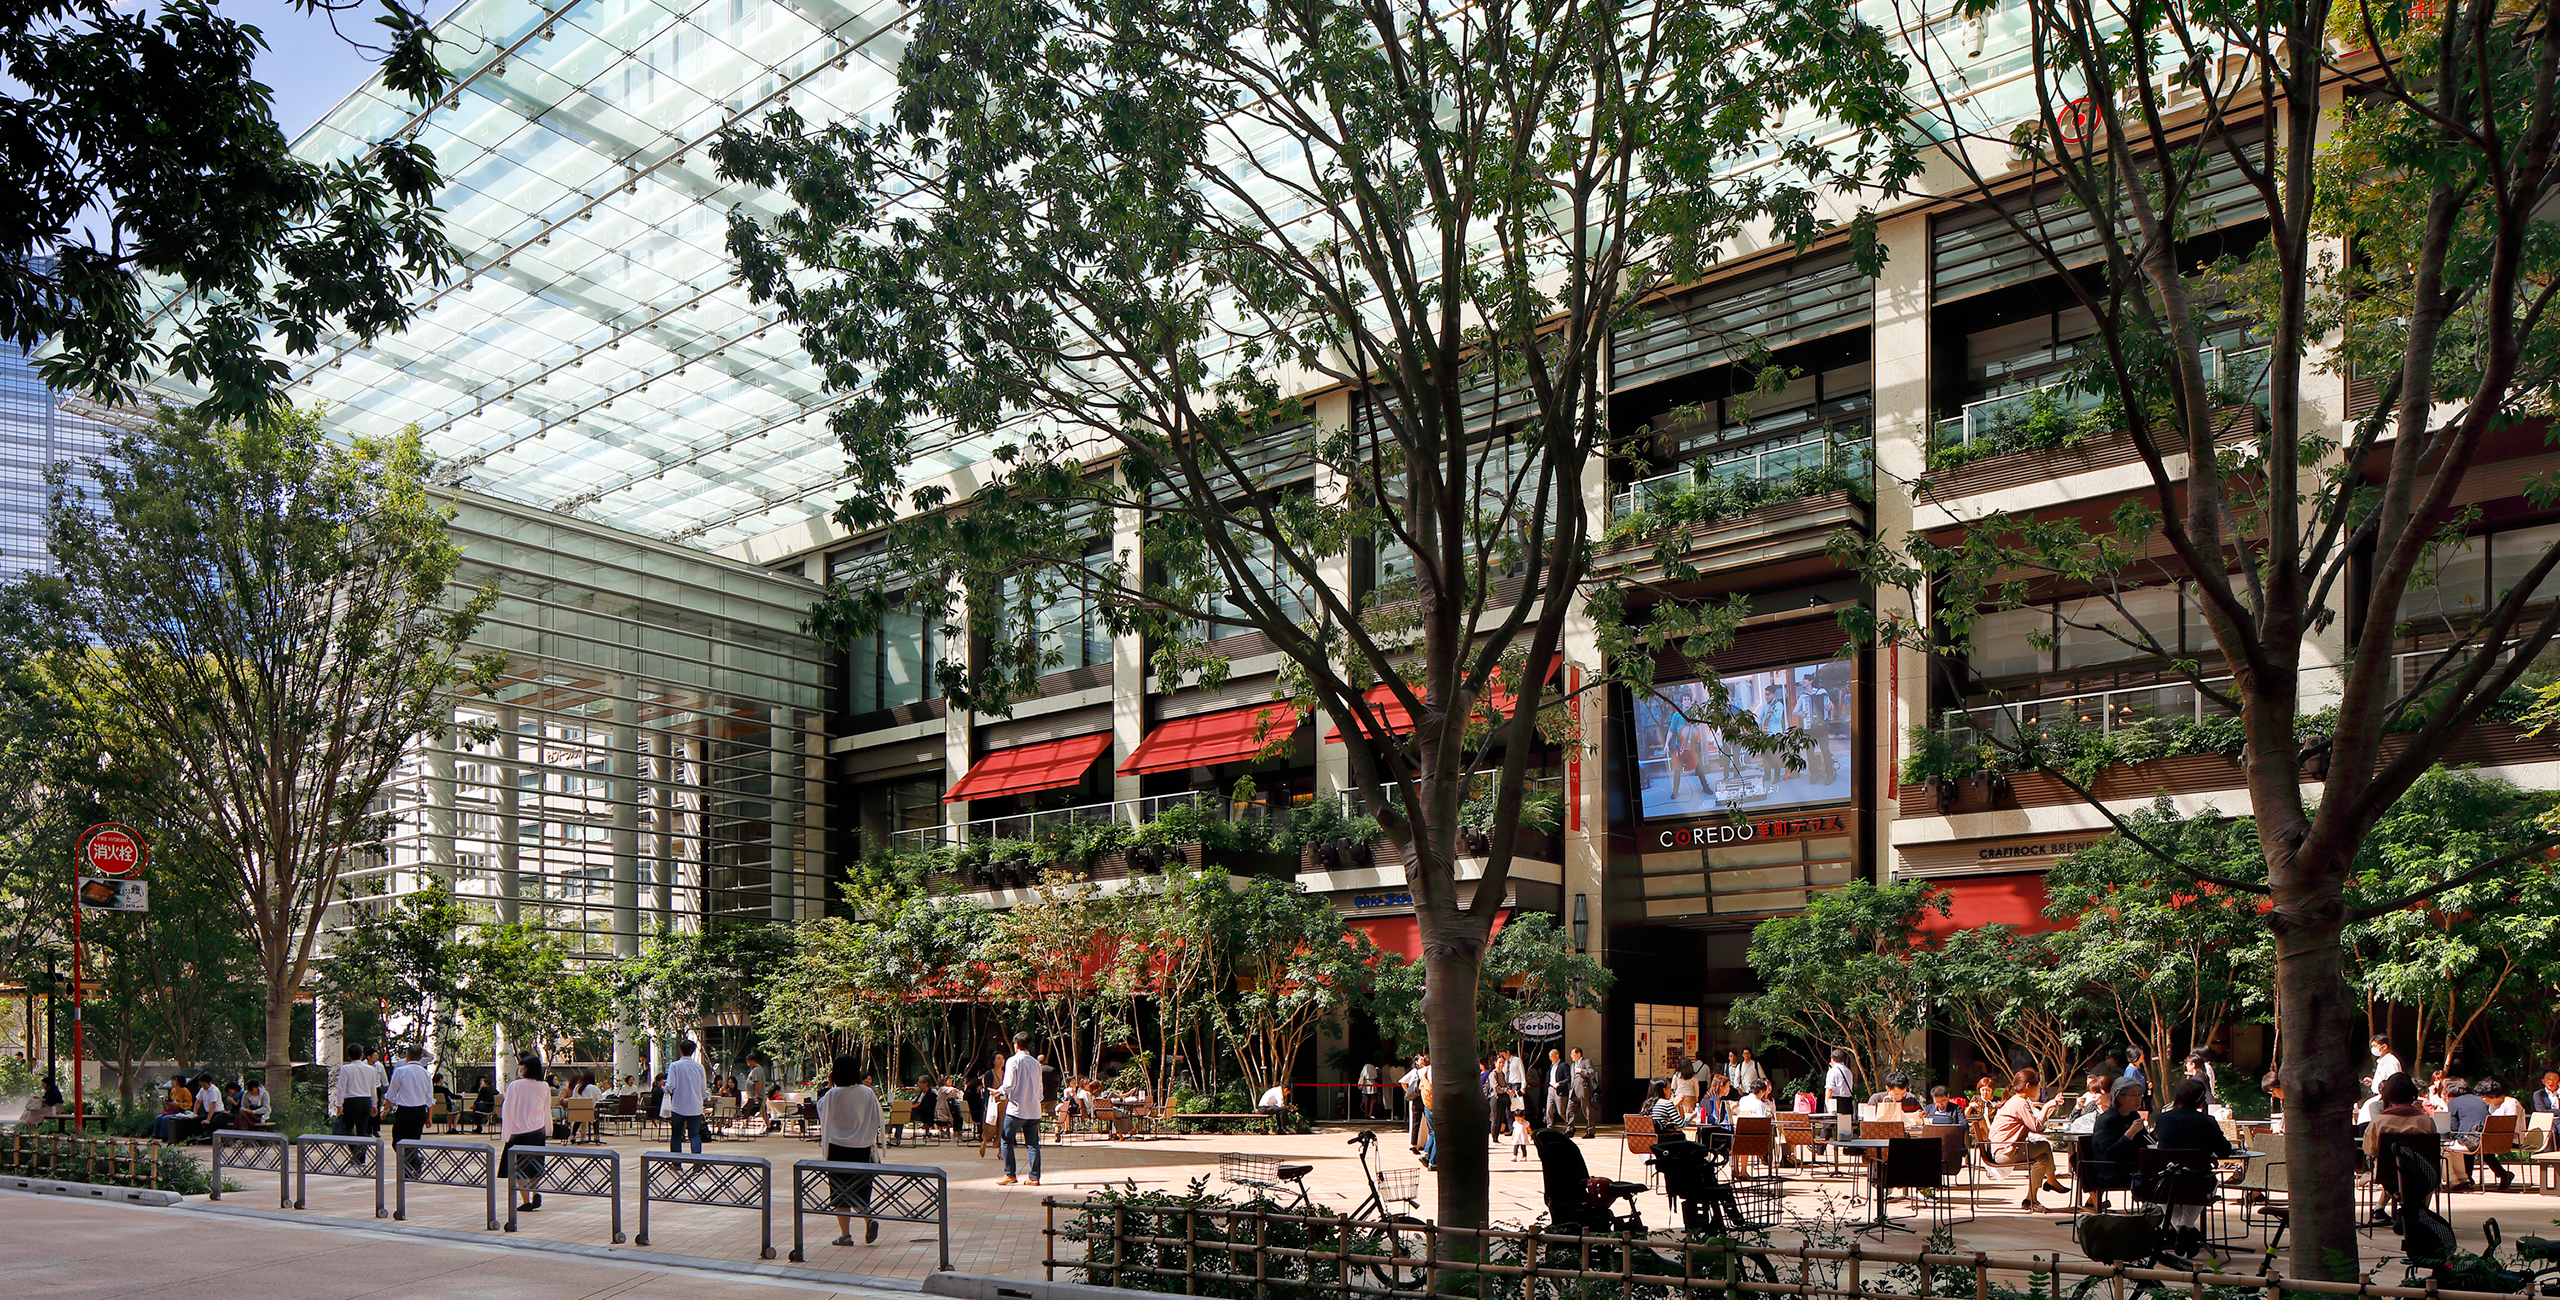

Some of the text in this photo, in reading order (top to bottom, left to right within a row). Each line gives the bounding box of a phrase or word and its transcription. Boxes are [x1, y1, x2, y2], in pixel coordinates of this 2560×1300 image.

[1659, 816, 1842, 848] COREDO 室町テラス
[94, 843, 133, 862] 消火栓
[1979, 844, 2046, 859] CRAFTROCK
[1354, 893, 1380, 908] Gino
